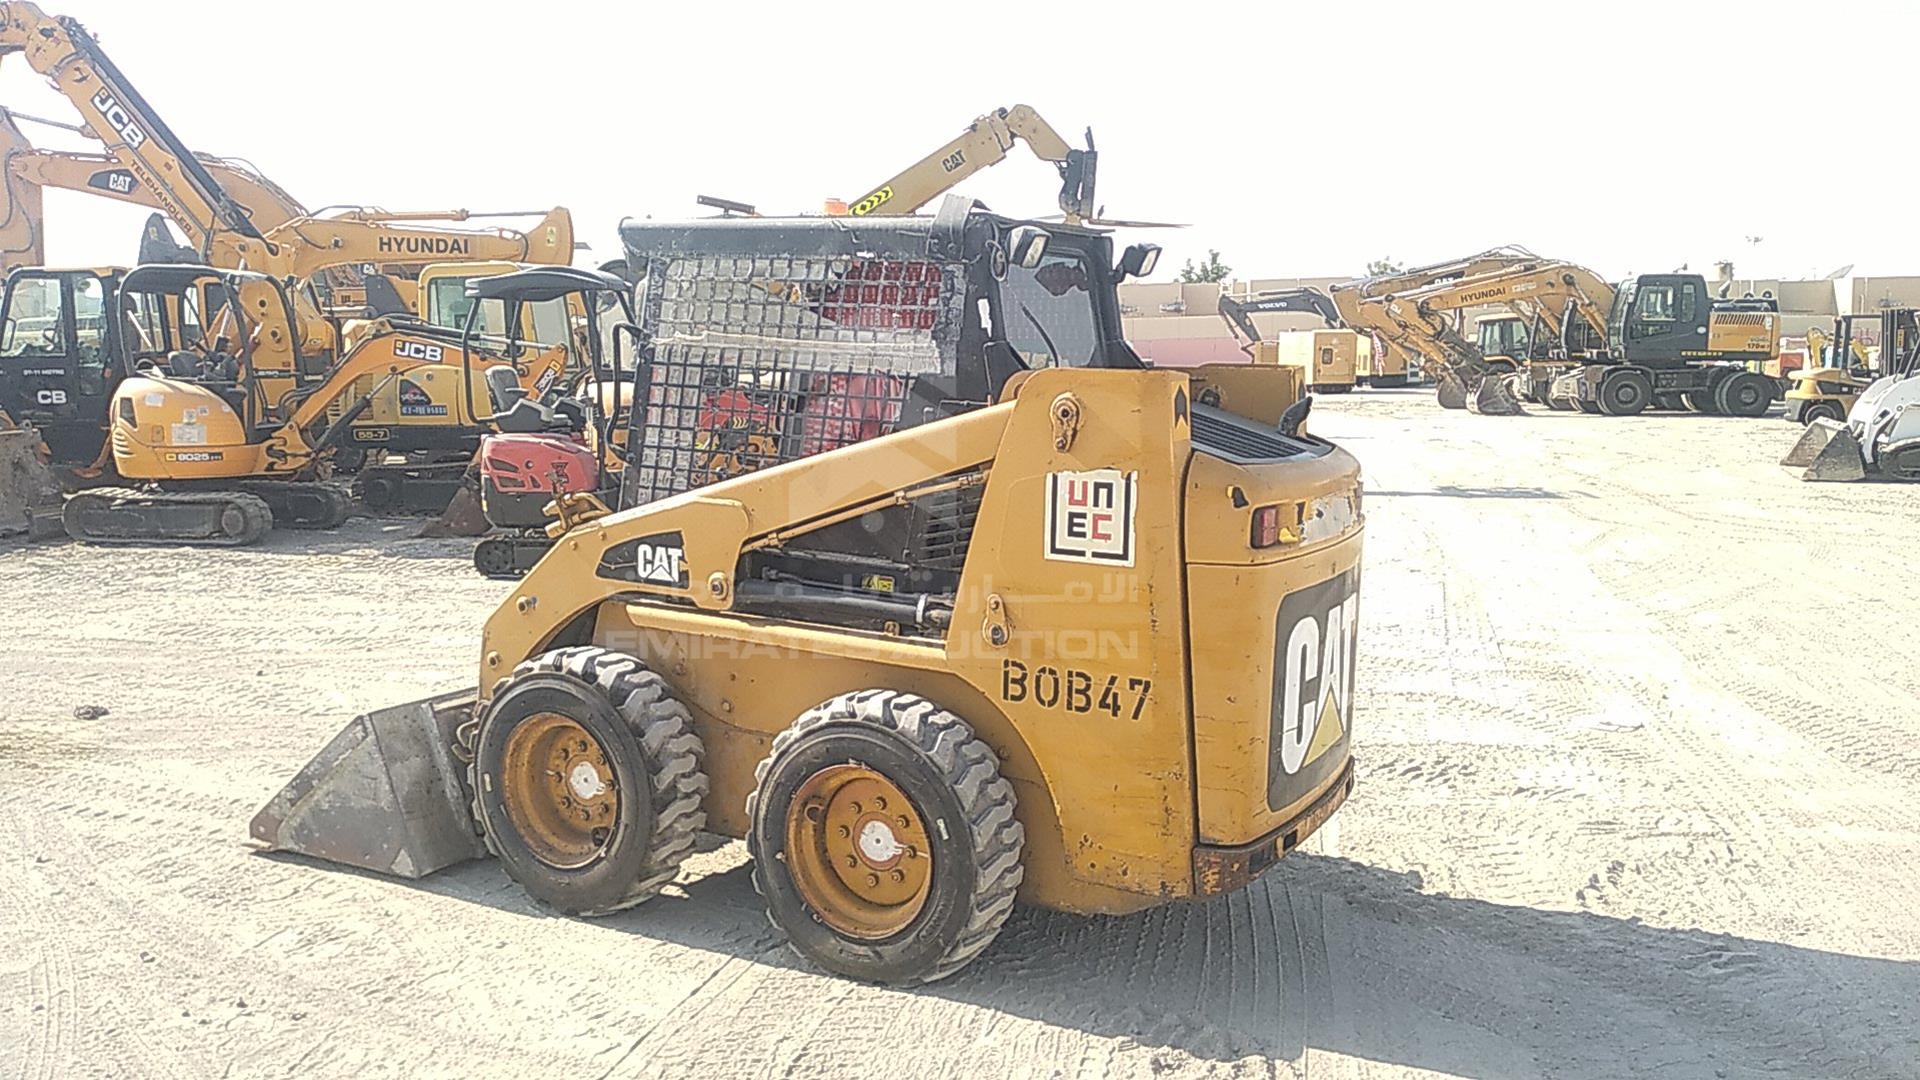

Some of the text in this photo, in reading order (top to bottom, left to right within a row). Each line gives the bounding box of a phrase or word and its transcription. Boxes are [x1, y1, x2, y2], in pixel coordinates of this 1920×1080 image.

[93, 90, 145, 148] JCB
[942, 149, 967, 172] CAT
[109, 173, 132, 192] CAT
[130, 158, 193, 232] TELEHANDLER
[378, 236, 469, 255] HYUNDAI
[1257, 301, 1288, 309] VOLVO
[1460, 287, 1506, 303] HYUNDAI
[395, 340, 442, 361] JCB
[1066, 511, 1113, 541] EC
[637, 543, 683, 583] CAT
[1281, 592, 1358, 775] CAT
